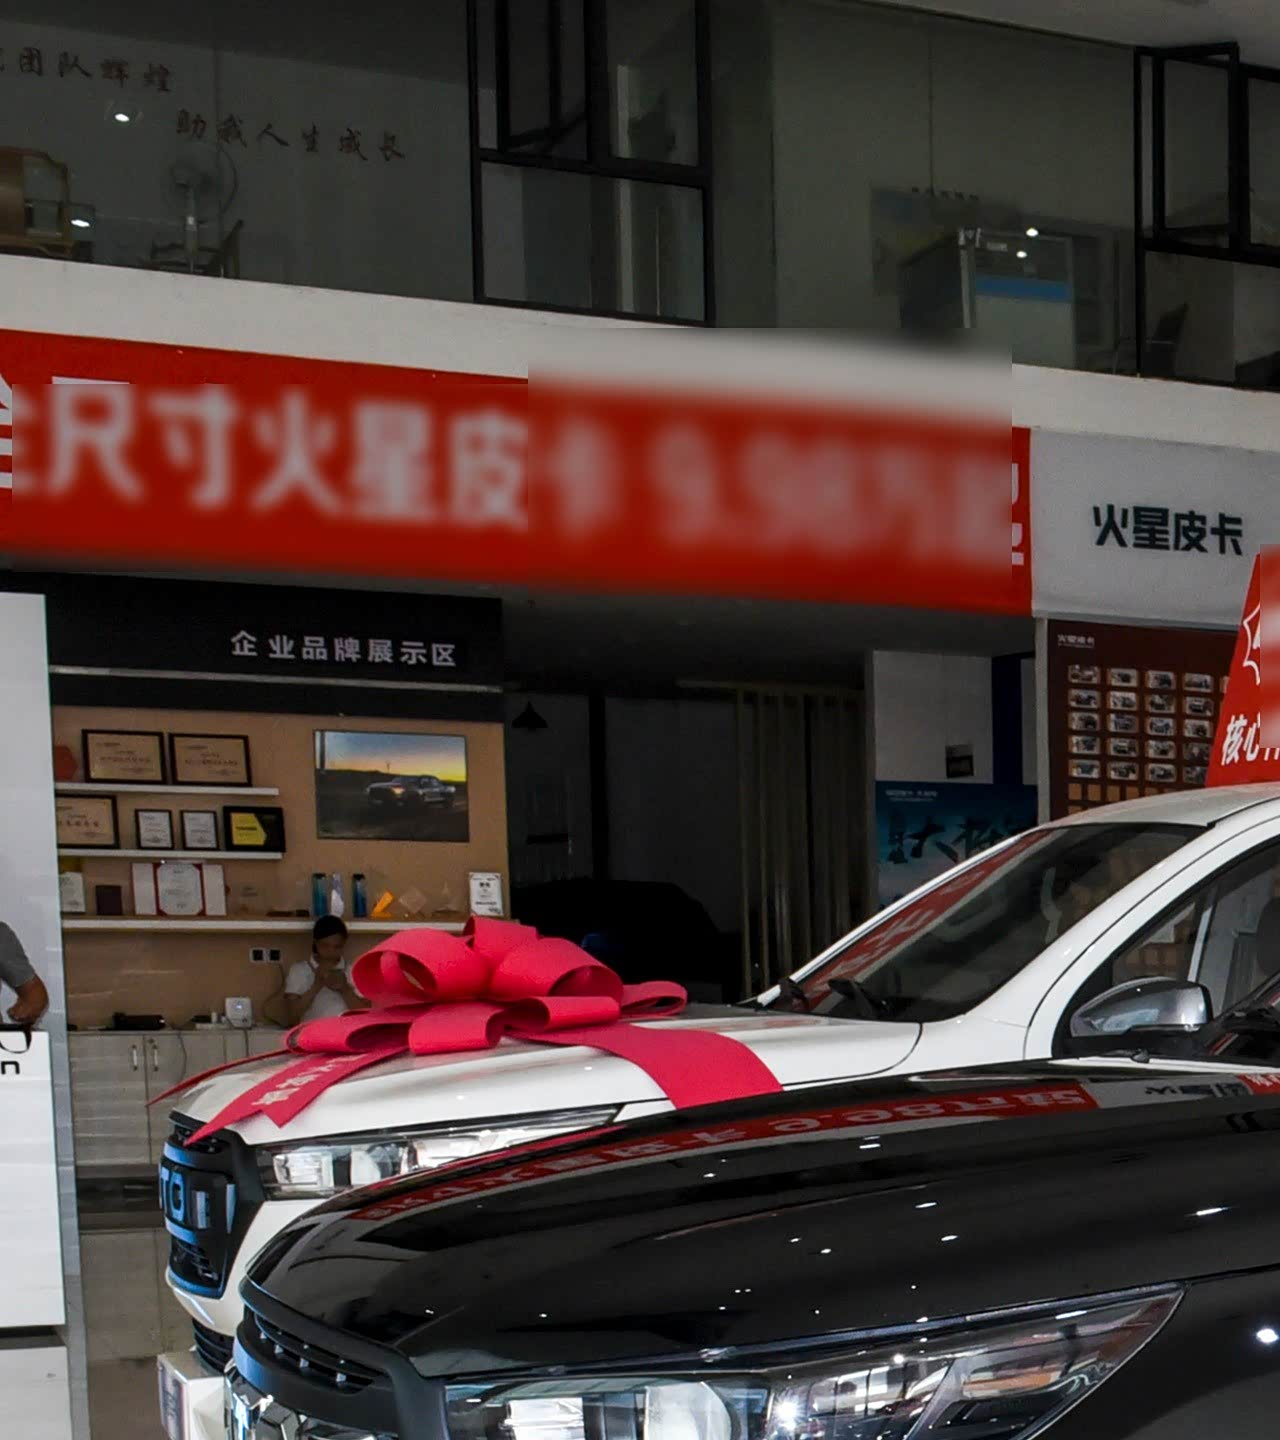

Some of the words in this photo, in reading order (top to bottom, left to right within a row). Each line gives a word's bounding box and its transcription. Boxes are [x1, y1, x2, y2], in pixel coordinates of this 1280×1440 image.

[0, 46, 174, 92] 团队辉煌
[1093, 503, 1243, 556] 火星皮卡
[230, 630, 457, 667] 企业品牌展示区
